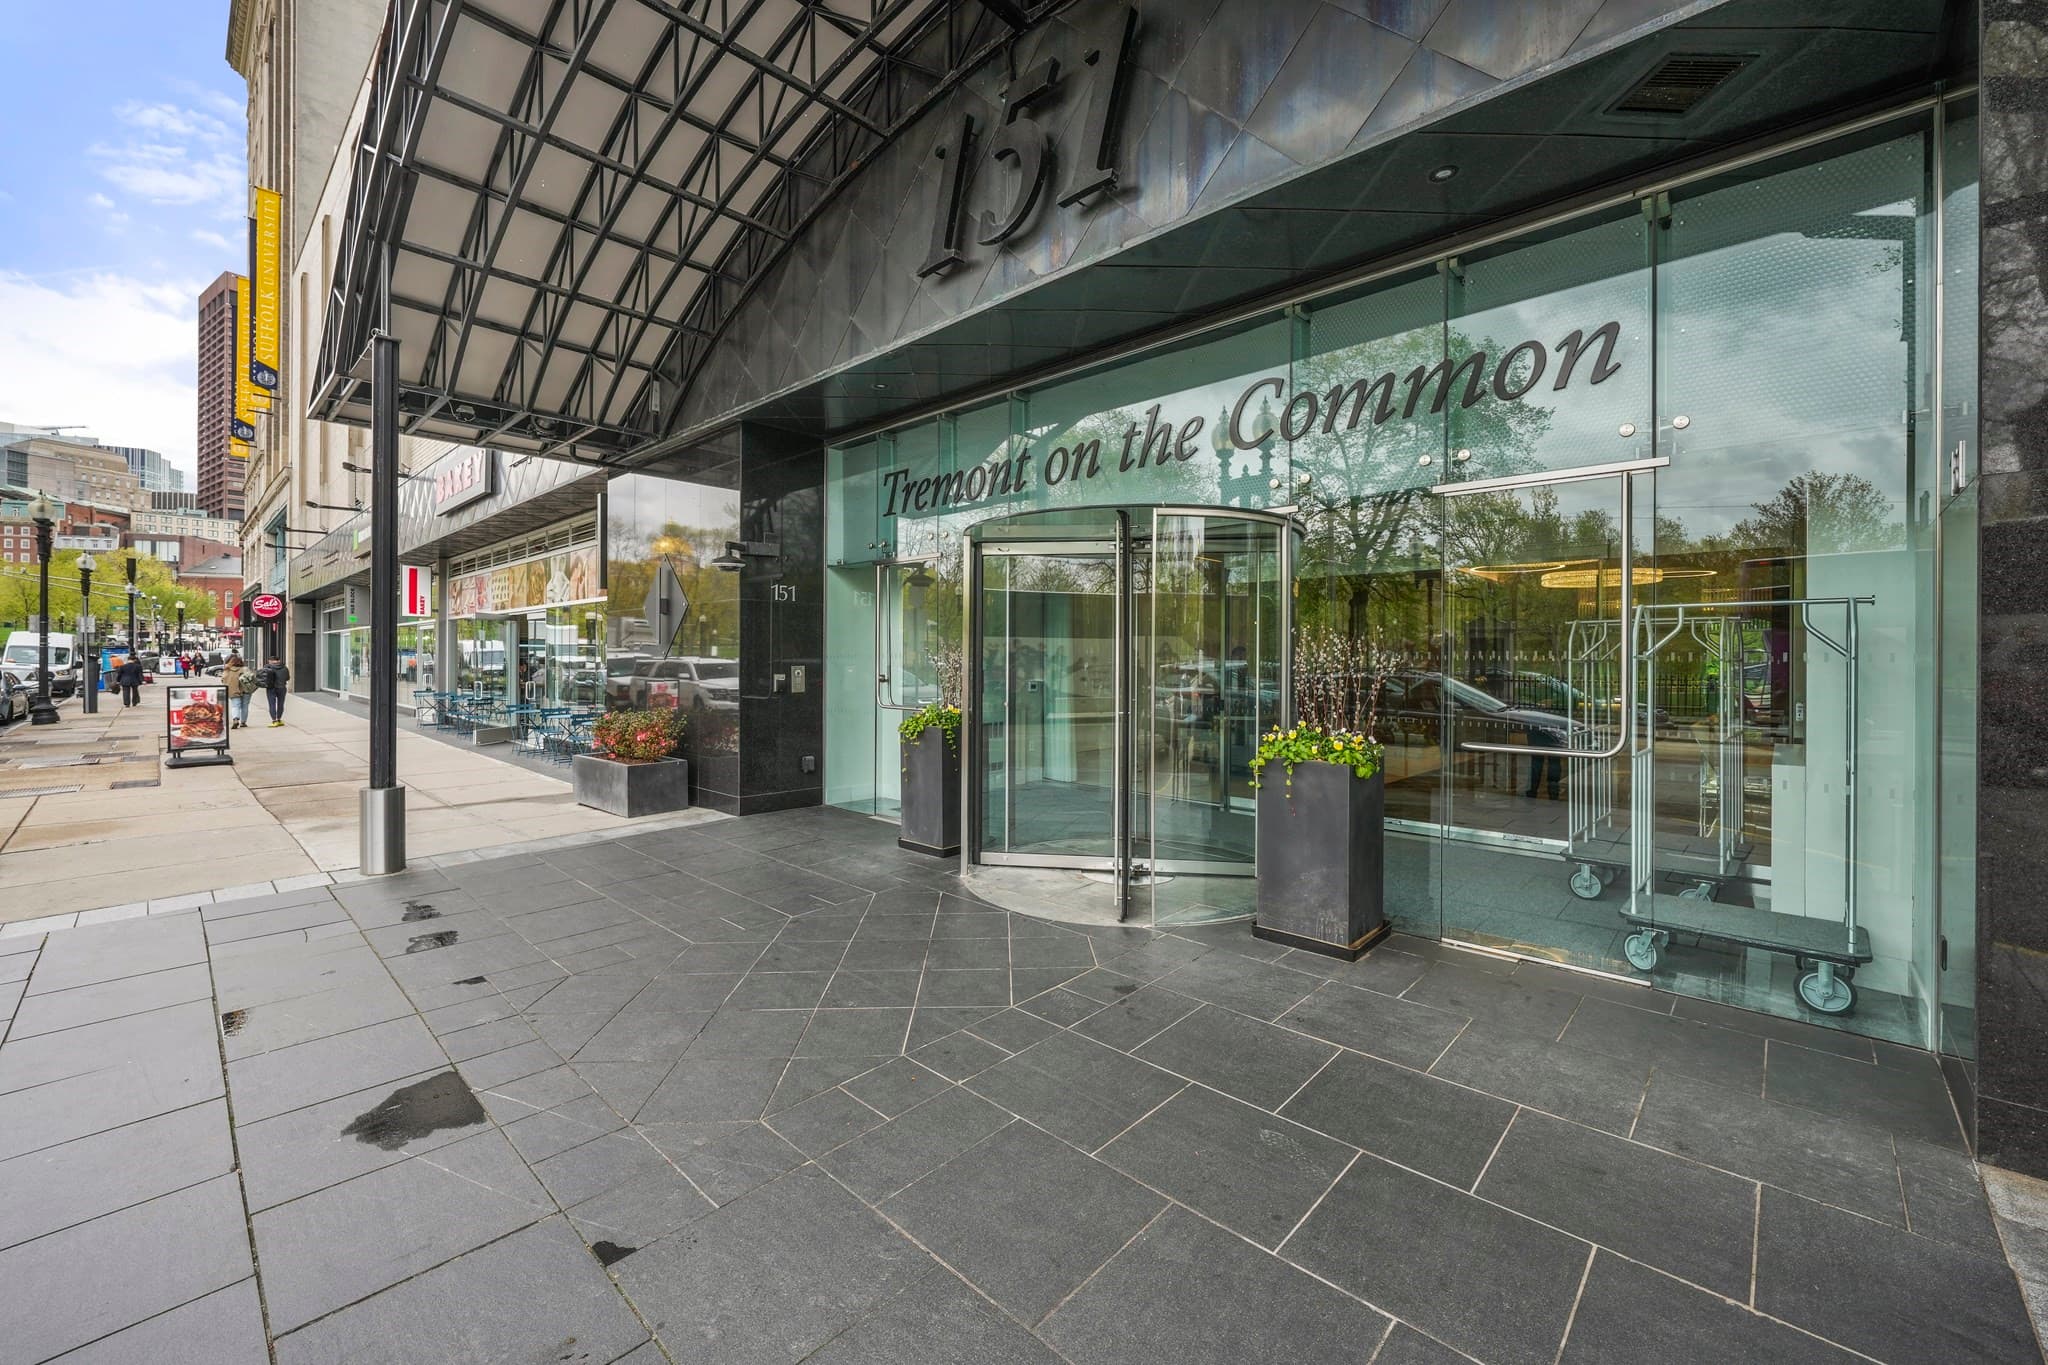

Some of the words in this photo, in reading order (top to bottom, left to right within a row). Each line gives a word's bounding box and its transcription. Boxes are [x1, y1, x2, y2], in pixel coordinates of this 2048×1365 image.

[916, 2, 1137, 279] 151
[262, 198, 276, 286] UNIVERSITY
[259, 289, 275, 361] SUFFOLK
[883, 447, 1031, 517] Tremont
[1044, 438, 1100, 486] on
[1118, 403, 1204, 473] the
[1228, 321, 1622, 451] Common
[436, 449, 485, 505] BAKEY
[770, 583, 796, 602] 151
